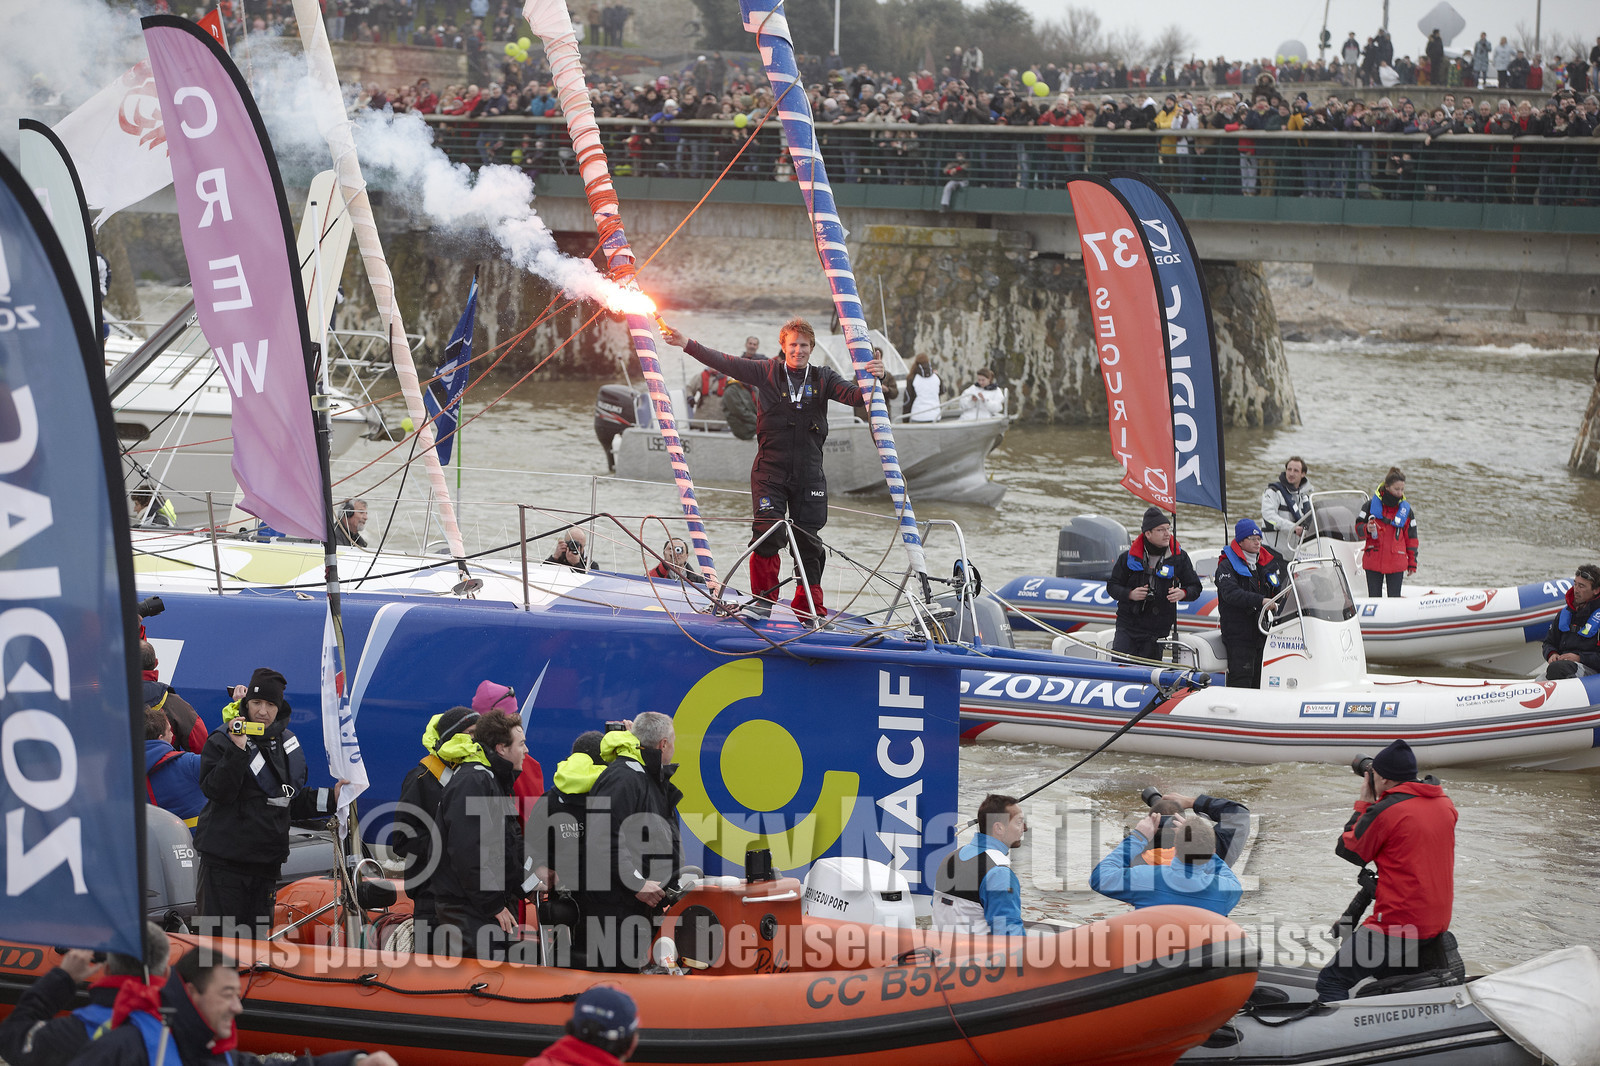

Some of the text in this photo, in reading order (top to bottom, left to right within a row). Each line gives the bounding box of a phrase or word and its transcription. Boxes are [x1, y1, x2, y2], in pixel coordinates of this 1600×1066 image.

[1017, 590, 1040, 598] ZODIAC
[1277, 641, 1305, 651] YAMAHA
[974, 672, 1149, 709] ZODIAC
[876, 670, 925, 884] MACIF
[173, 848, 194, 859] 150
[828, 896, 849, 912] PORT
[806, 974, 868, 1009] CC
[1354, 1004, 1446, 1027] SERVICE DU PORT
